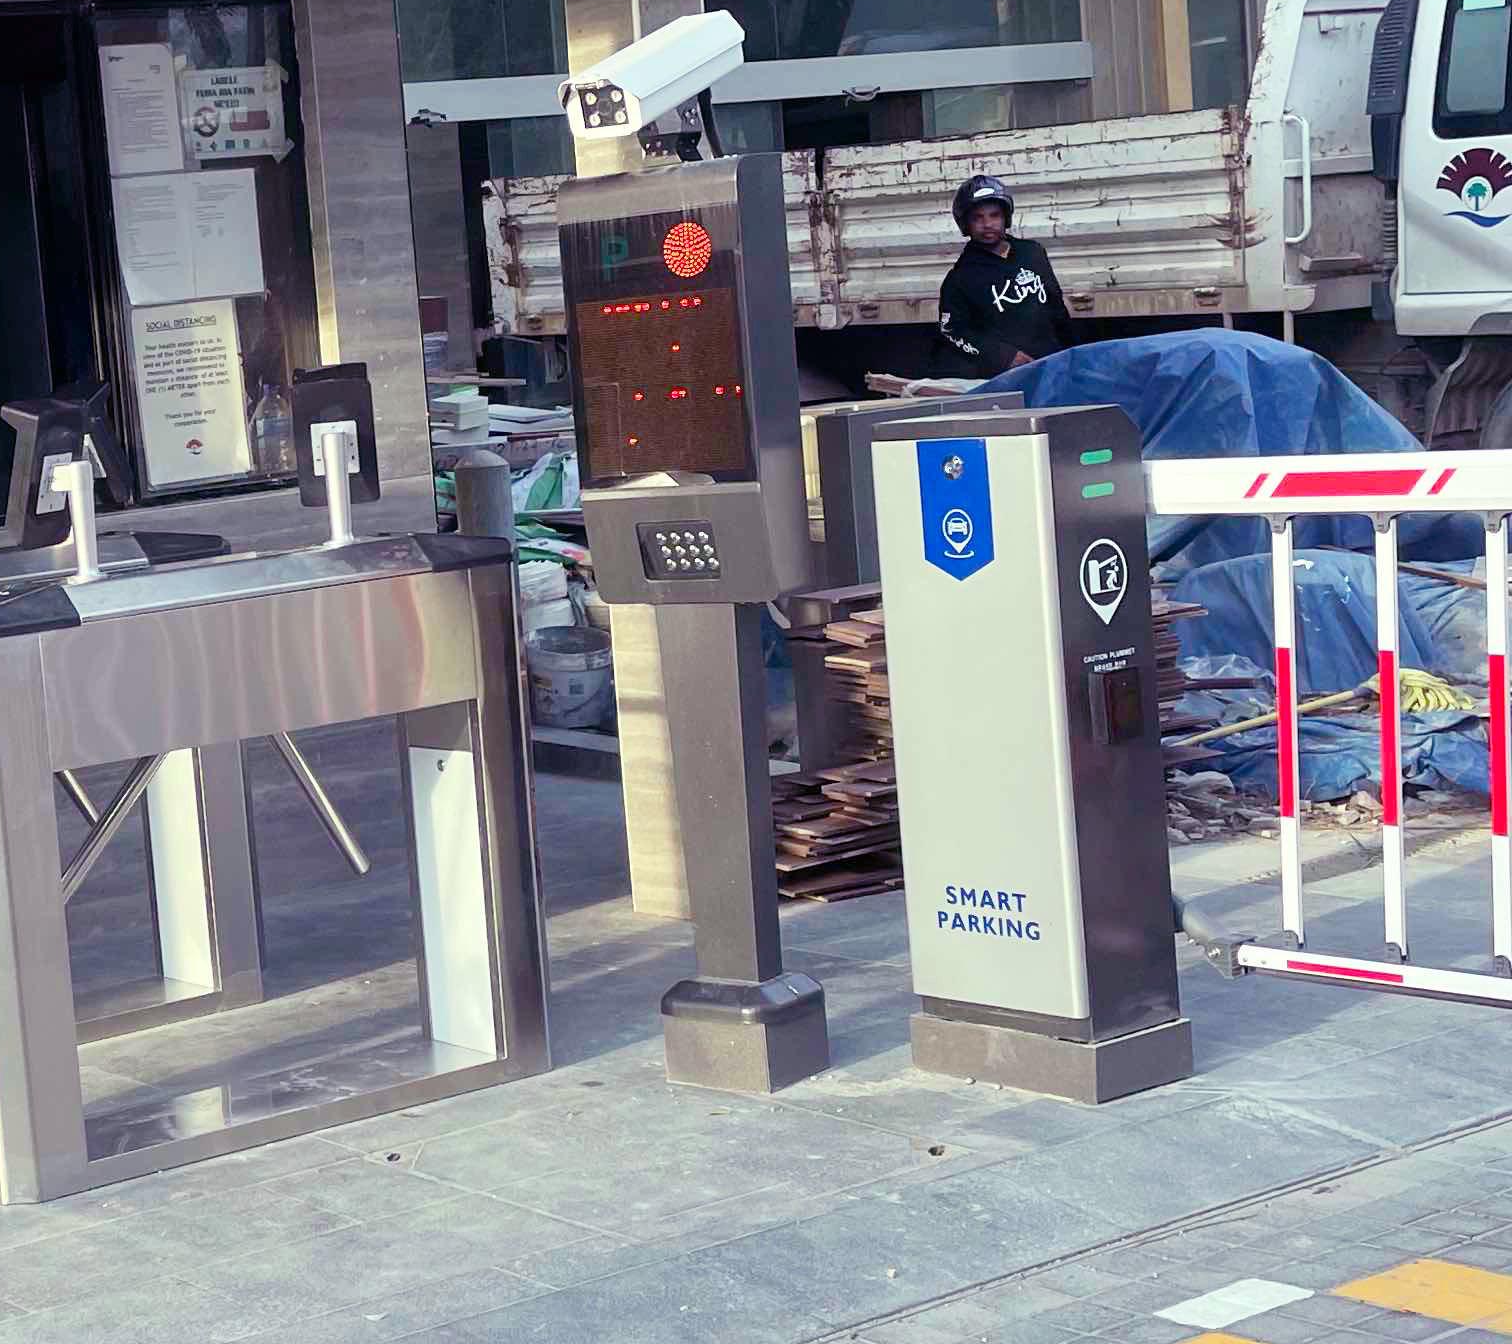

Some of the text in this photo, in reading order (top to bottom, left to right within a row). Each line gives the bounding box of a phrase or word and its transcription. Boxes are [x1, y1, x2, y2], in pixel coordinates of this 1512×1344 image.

[991, 274, 1047, 312] King
[144, 314, 217, 330] SOCIAL DISTANCING
[1083, 652, 1109, 664] CAUTION
[945, 884, 1027, 913] SMART
[936, 910, 1041, 941] PARKING
